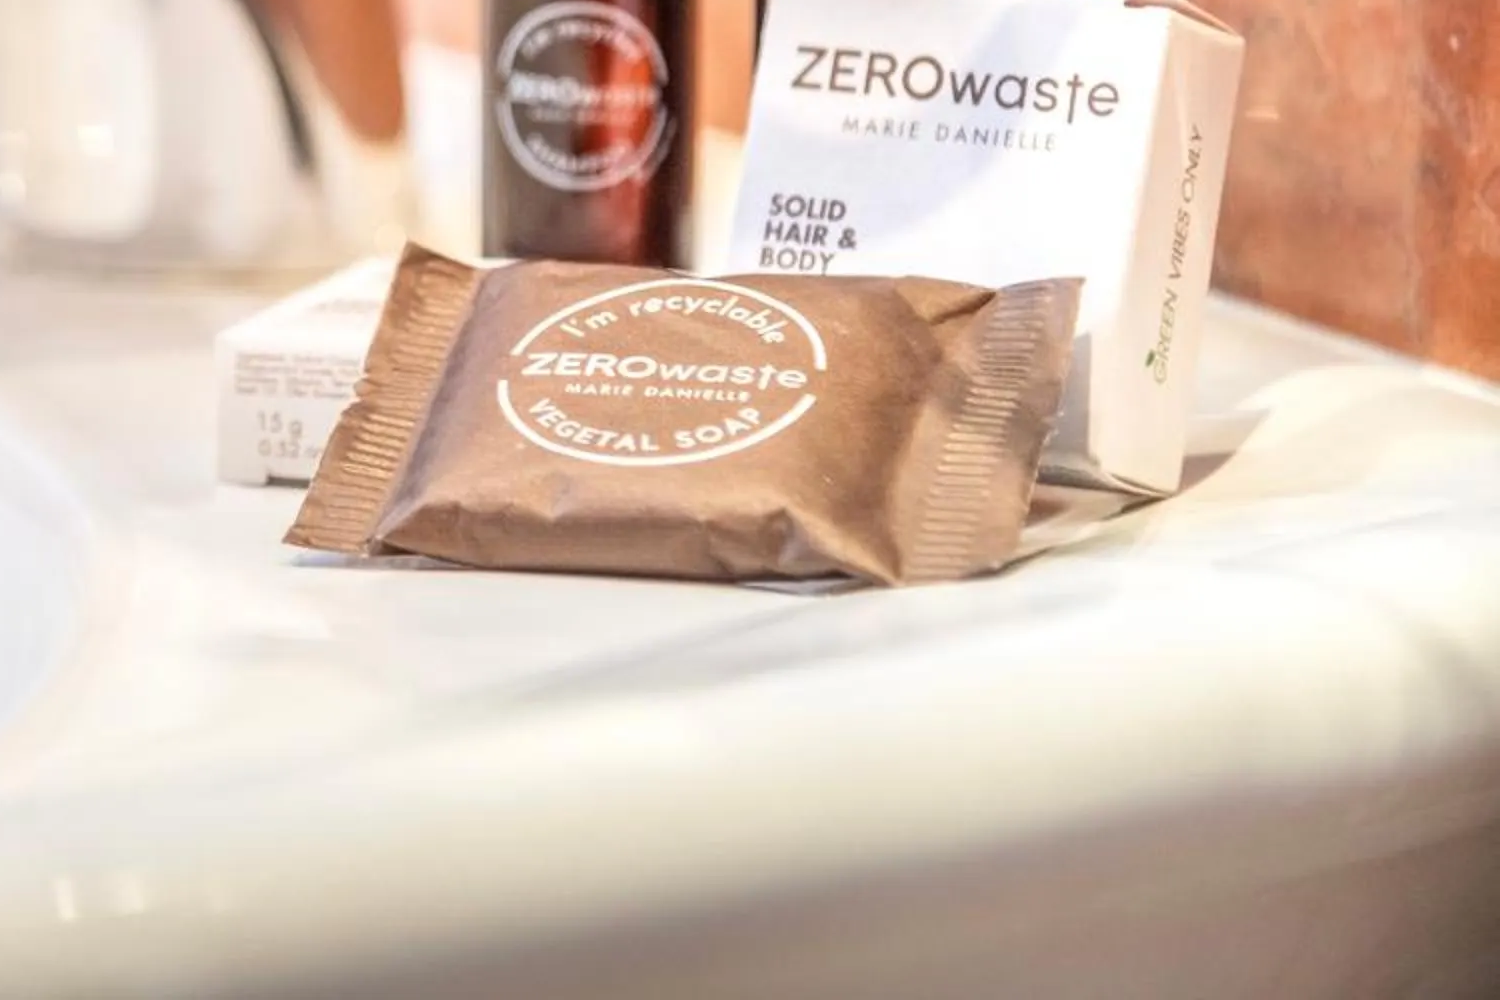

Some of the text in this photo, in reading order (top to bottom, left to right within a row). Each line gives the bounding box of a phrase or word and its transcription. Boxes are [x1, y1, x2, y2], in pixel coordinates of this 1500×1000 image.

[791, 46, 1120, 124] ZEROwaste
[842, 116, 1056, 152] MARIE DANIELLE
[770, 193, 847, 221] SOLID
[764, 221, 857, 250] HAIR &
[759, 247, 835, 276] BODY
[1153, 124, 1203, 385] GREEN VIBES ONLY
[560, 295, 786, 344] I'm recyclable
[521, 351, 808, 390] ZEROwaste
[565, 383, 752, 402] MARIE DANIELLE
[528, 397, 763, 451] VEGETAL SOAP
